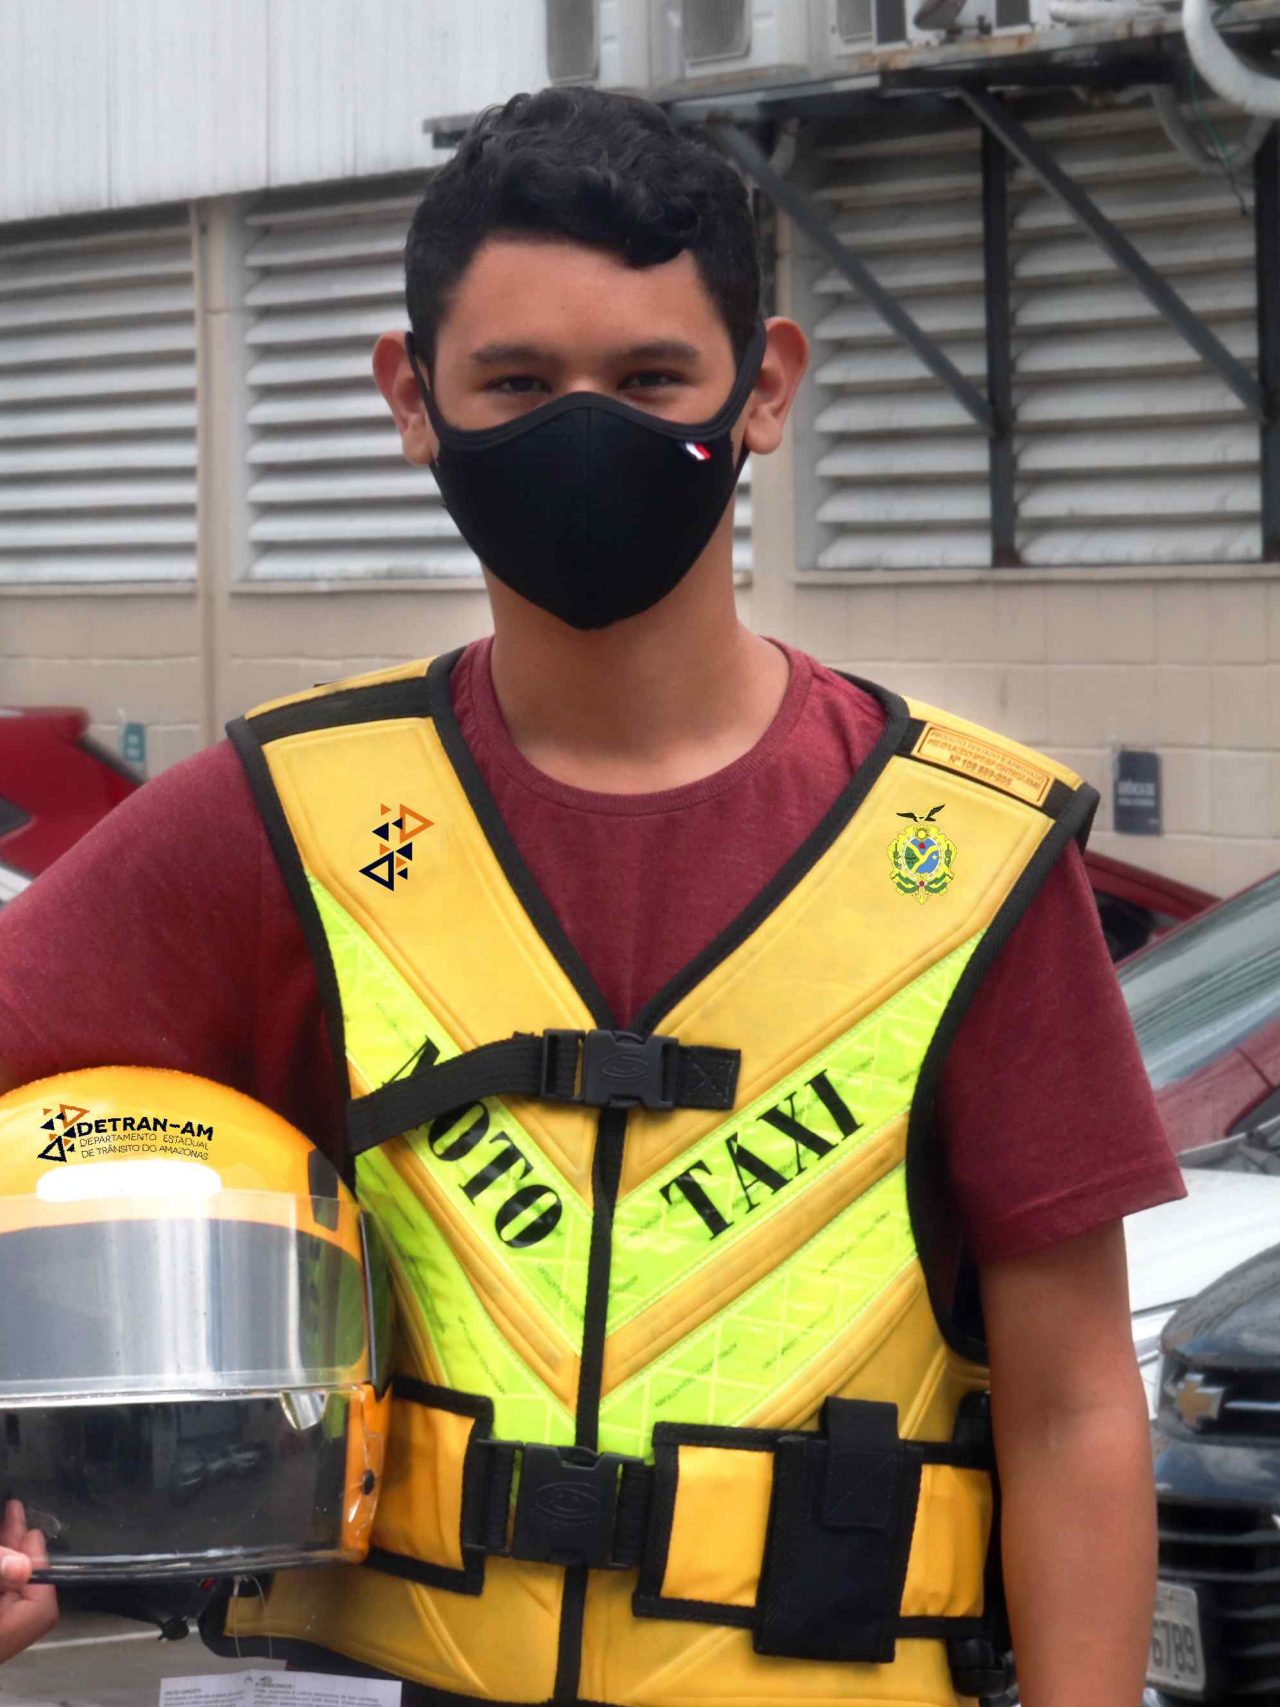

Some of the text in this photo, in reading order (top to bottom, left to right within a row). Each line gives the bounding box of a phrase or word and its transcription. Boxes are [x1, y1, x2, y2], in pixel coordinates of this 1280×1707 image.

[76, 1117, 214, 1141] DETRAN-AM
[79, 1133, 209, 1151] DEPARTAMENTO ESTADUAL
[81, 1144, 209, 1161] DE TRÂNSITO DO AMAZONAS
[659, 1069, 864, 1240] TAXI
